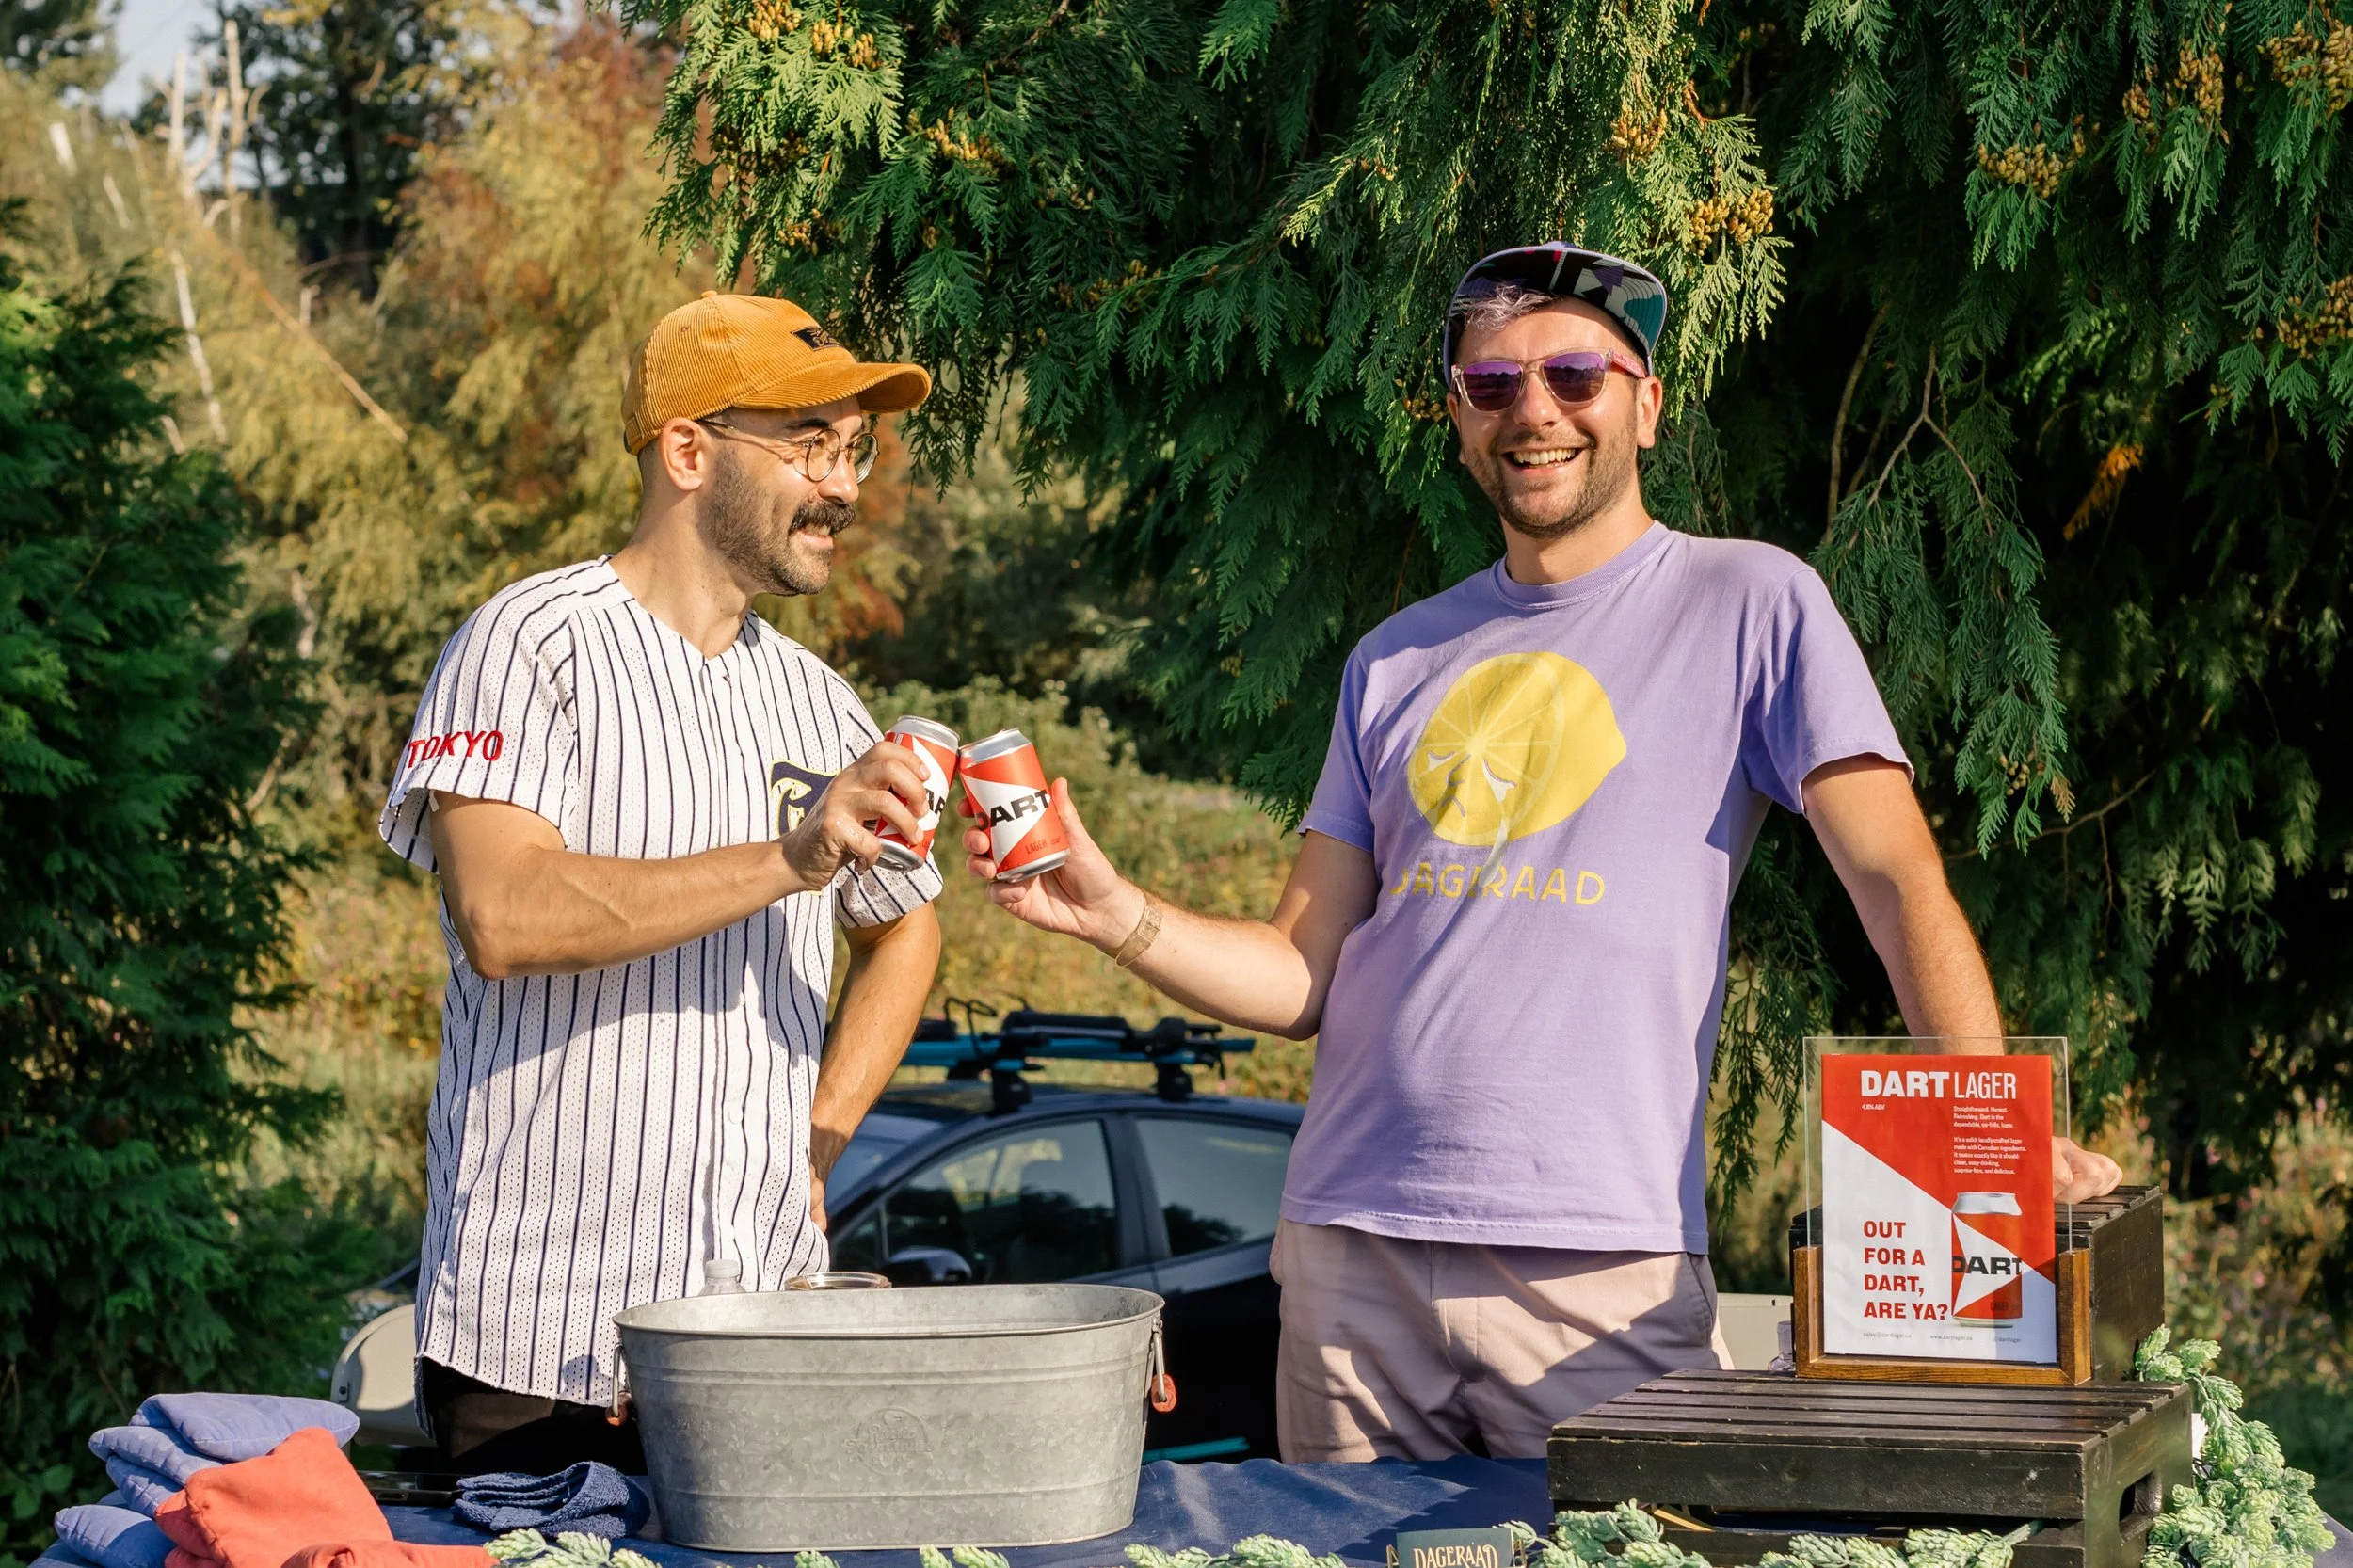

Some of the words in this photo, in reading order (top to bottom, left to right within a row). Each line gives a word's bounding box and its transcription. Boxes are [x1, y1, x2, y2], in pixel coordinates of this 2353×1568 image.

[406, 729, 504, 768] TOKYO
[1025, 840, 1048, 855] LAGER
[1861, 1070, 1950, 1098] DART
[1953, 1071, 2017, 1099] LAGER
[1864, 1220, 1906, 1239] OUT
[1864, 1247, 1906, 1265] FOR
[1912, 1249, 1926, 1266] A
[1864, 1274, 1925, 1297] DART,
[1864, 1301, 1907, 1319] ARE
[1911, 1303, 1948, 1320] YA?
